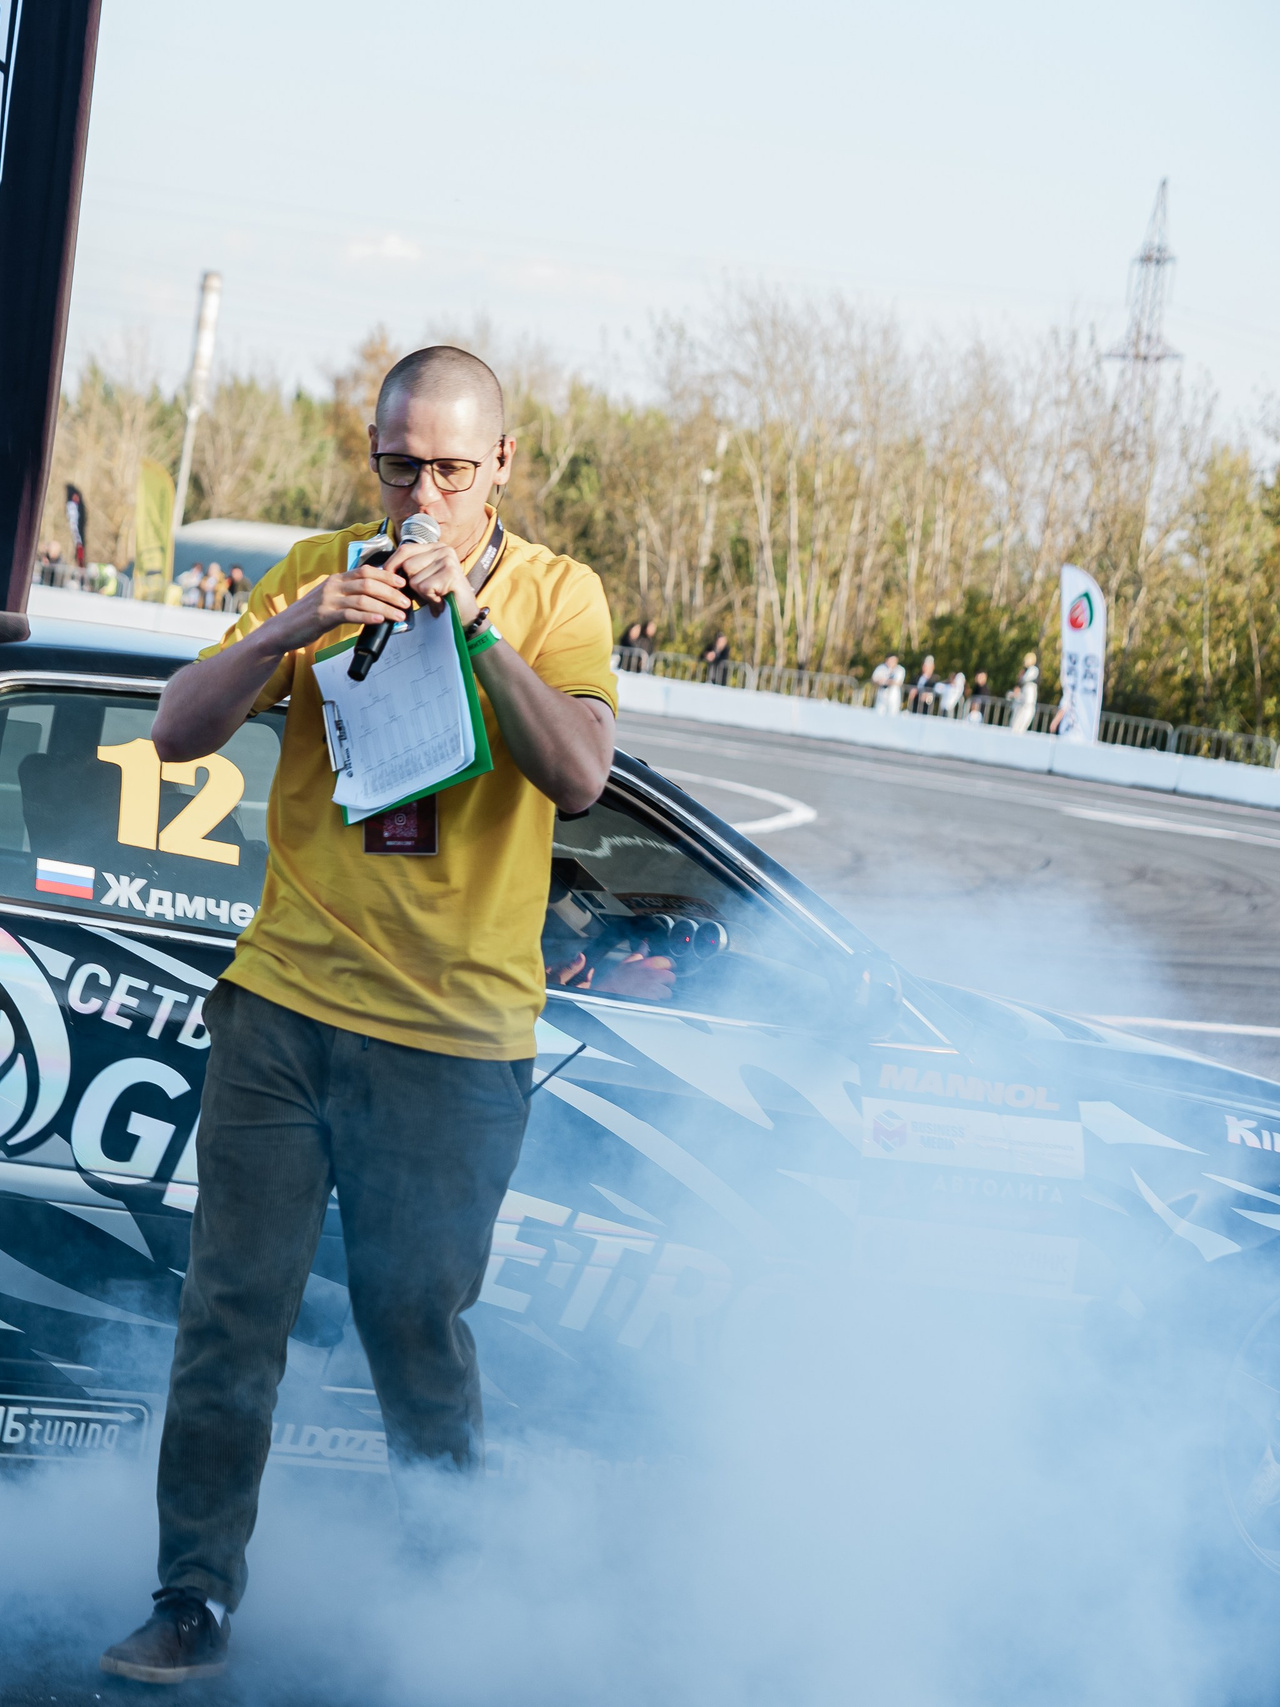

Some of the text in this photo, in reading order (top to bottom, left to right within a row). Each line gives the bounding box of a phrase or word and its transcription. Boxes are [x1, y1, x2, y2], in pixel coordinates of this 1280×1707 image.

[97, 738, 245, 866] 12
[100, 872, 260, 927] Ждмче
[67, 963, 211, 1050] СЕТЬ
[879, 1064, 1060, 1111] MANNOL
[911, 1121, 965, 1137] BUSINESS
[920, 1136, 956, 1150] MEDIA
[933, 1174, 1063, 1204] АВТОЛИГА
[270, 1422, 388, 1461] LLDOZE
